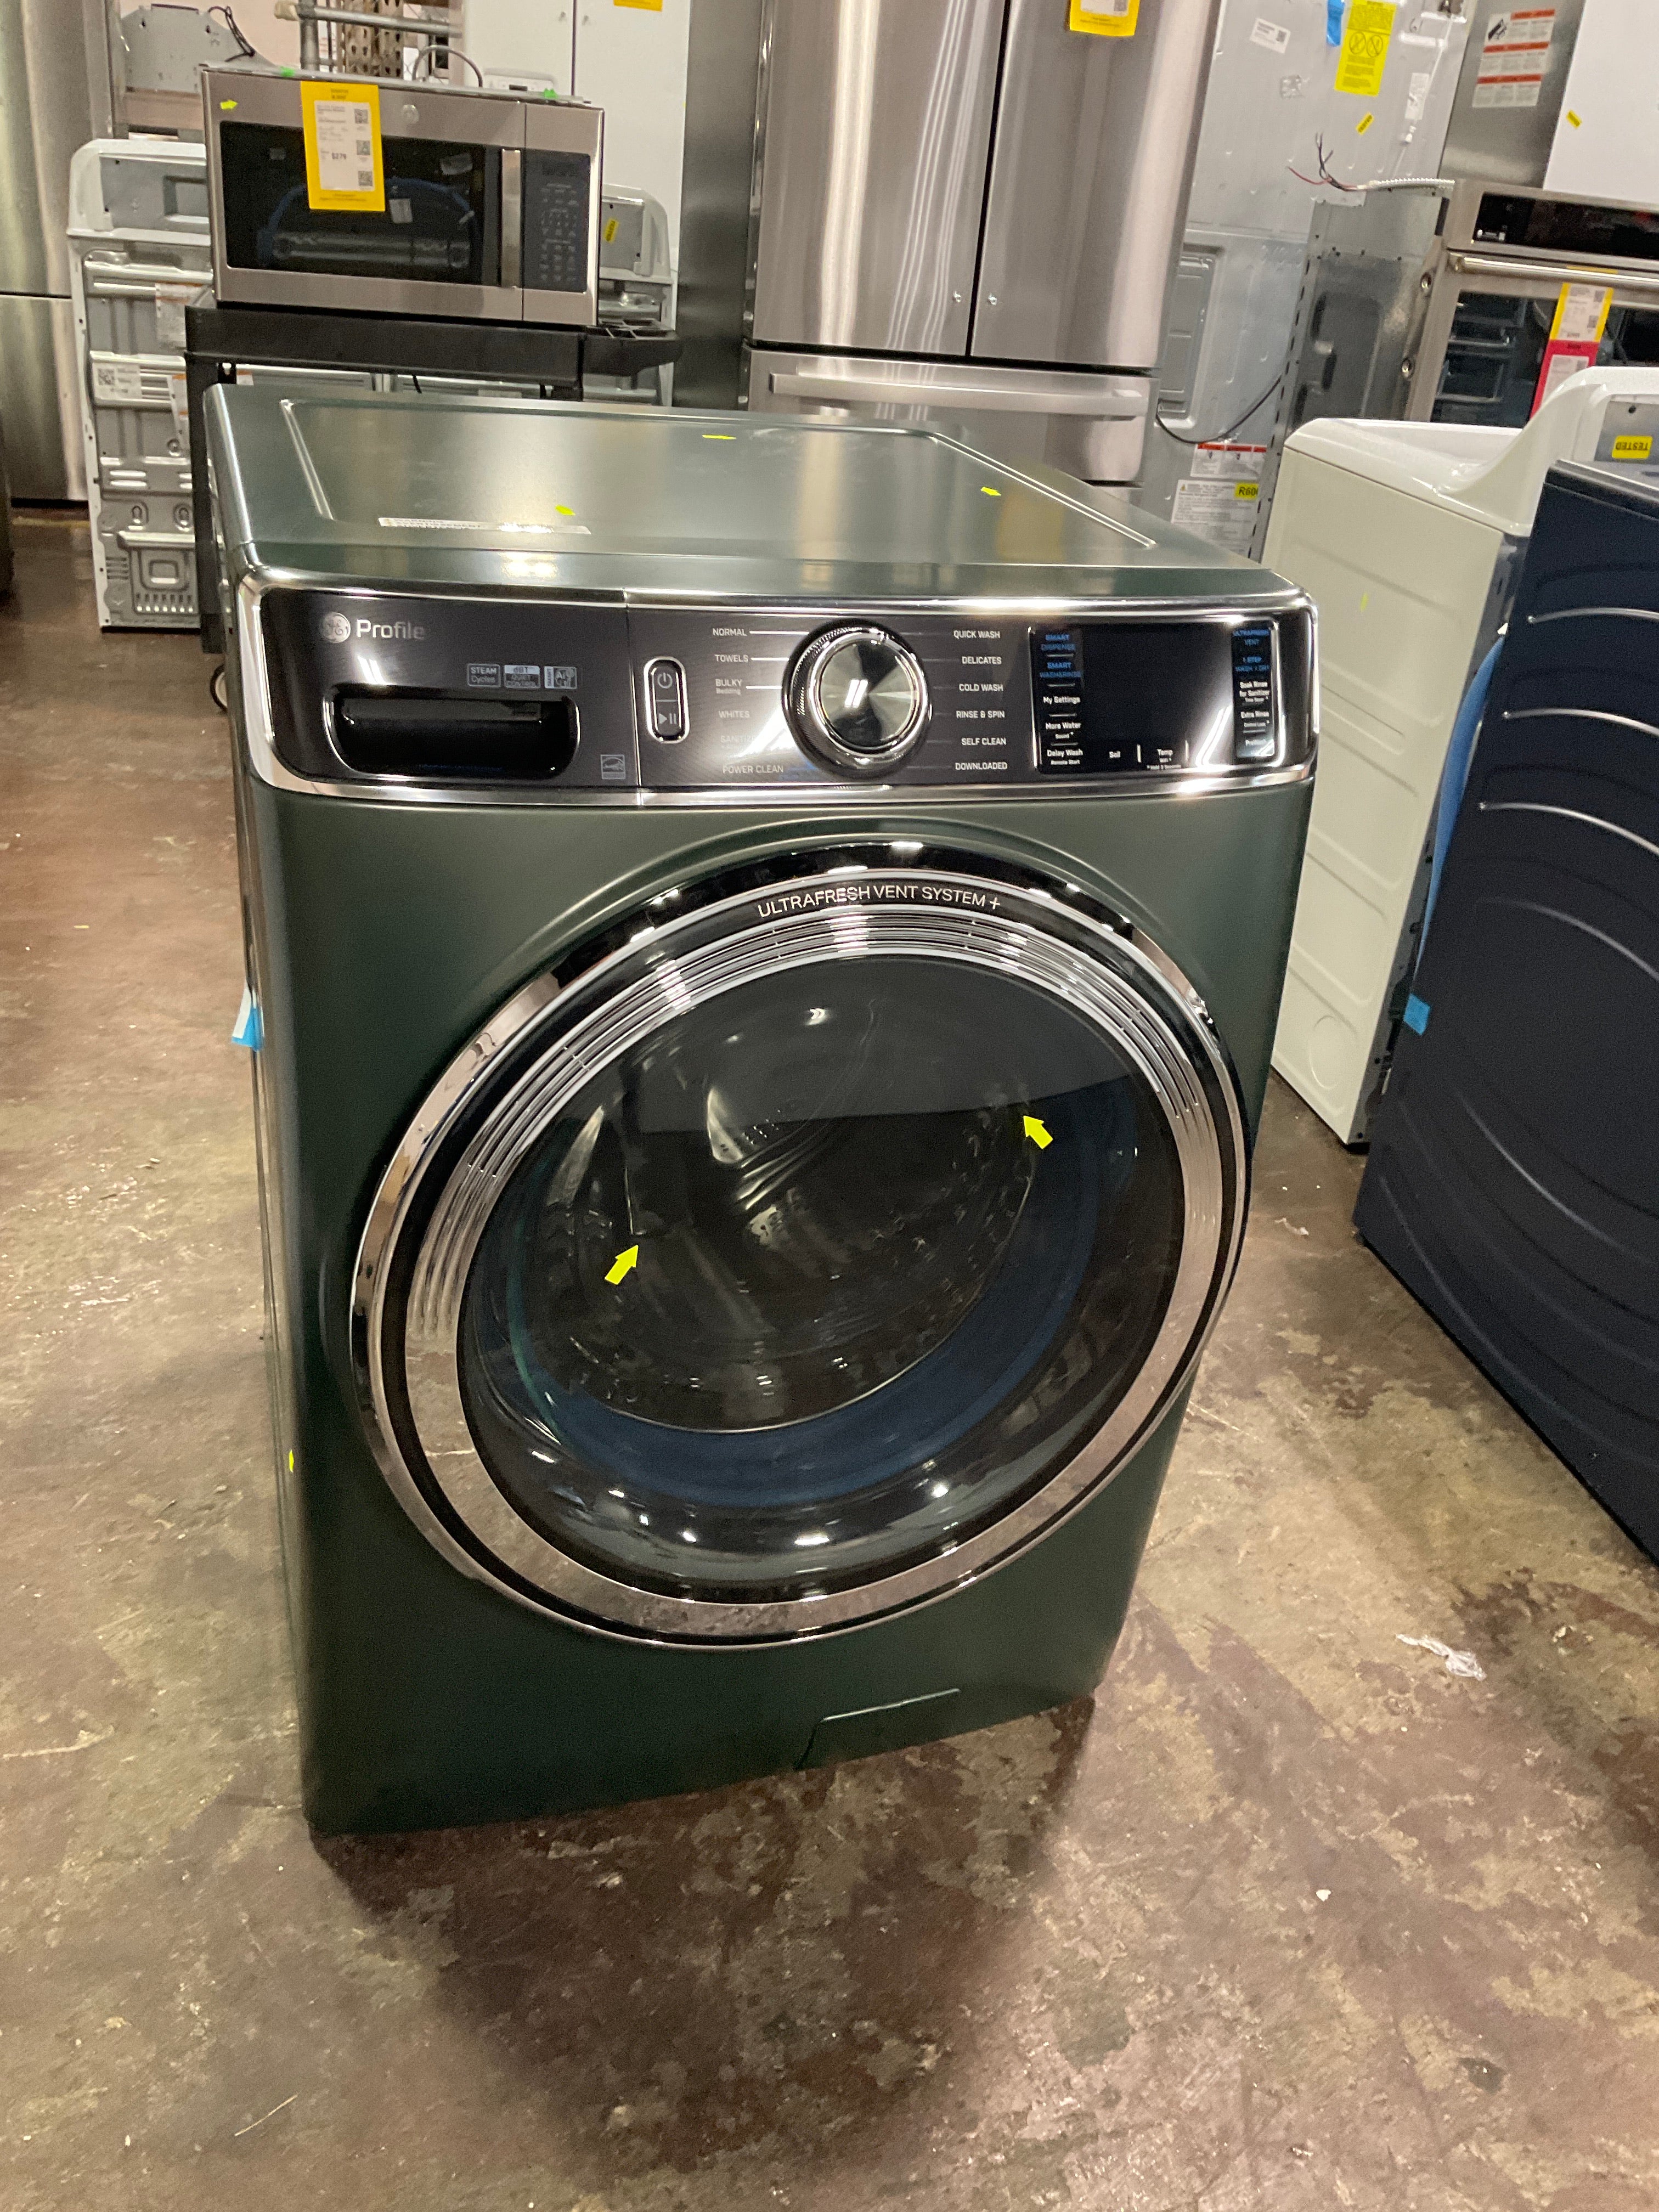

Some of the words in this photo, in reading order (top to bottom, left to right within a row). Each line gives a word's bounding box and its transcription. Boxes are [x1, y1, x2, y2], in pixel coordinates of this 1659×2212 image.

[1615, 442, 1648, 450] TESTED
[357, 619, 425, 640] Profile
[953, 630, 977, 639] QUICK
[962, 656, 1002, 664] DELICATES
[1043, 696, 1052, 704] My
[961, 737, 980, 746] SELF
[981, 737, 1007, 746] CLEAN
[723, 765, 753, 774] POWER
[755, 765, 784, 773] CLEAN
[955, 761, 1008, 770] DOWNLOADED
[758, 885, 871, 917] ULTRAFRESH
[873, 885, 918, 899] VENT
[922, 887, 986, 906] SYSTEM
[989, 897, 1001, 910] +
